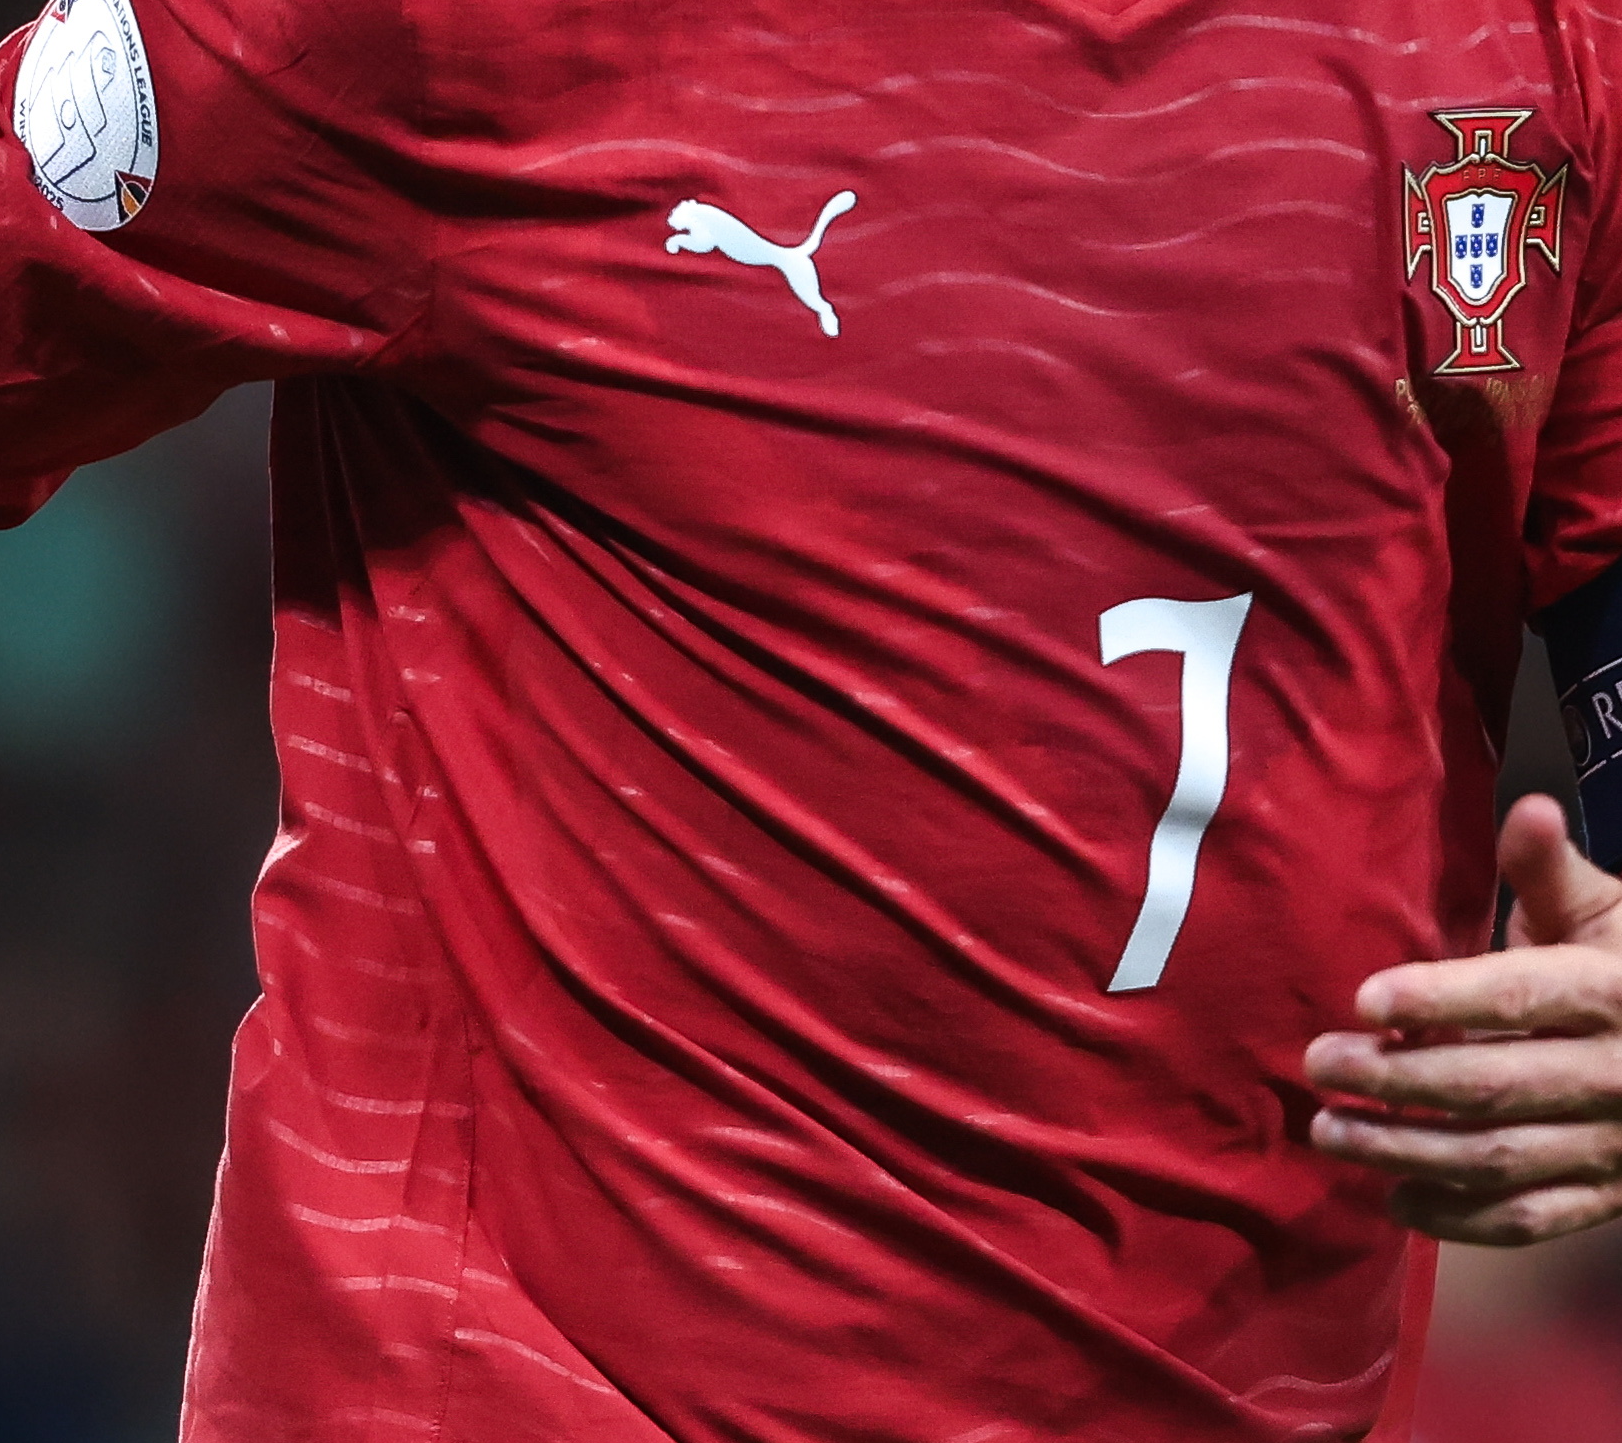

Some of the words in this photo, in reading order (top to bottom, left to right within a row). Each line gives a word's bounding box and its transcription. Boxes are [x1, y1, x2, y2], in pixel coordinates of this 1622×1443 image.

[134, 66, 154, 148] LEAGUE
[32, 174, 65, 212] 2025
[1098, 591, 1254, 994] 7
